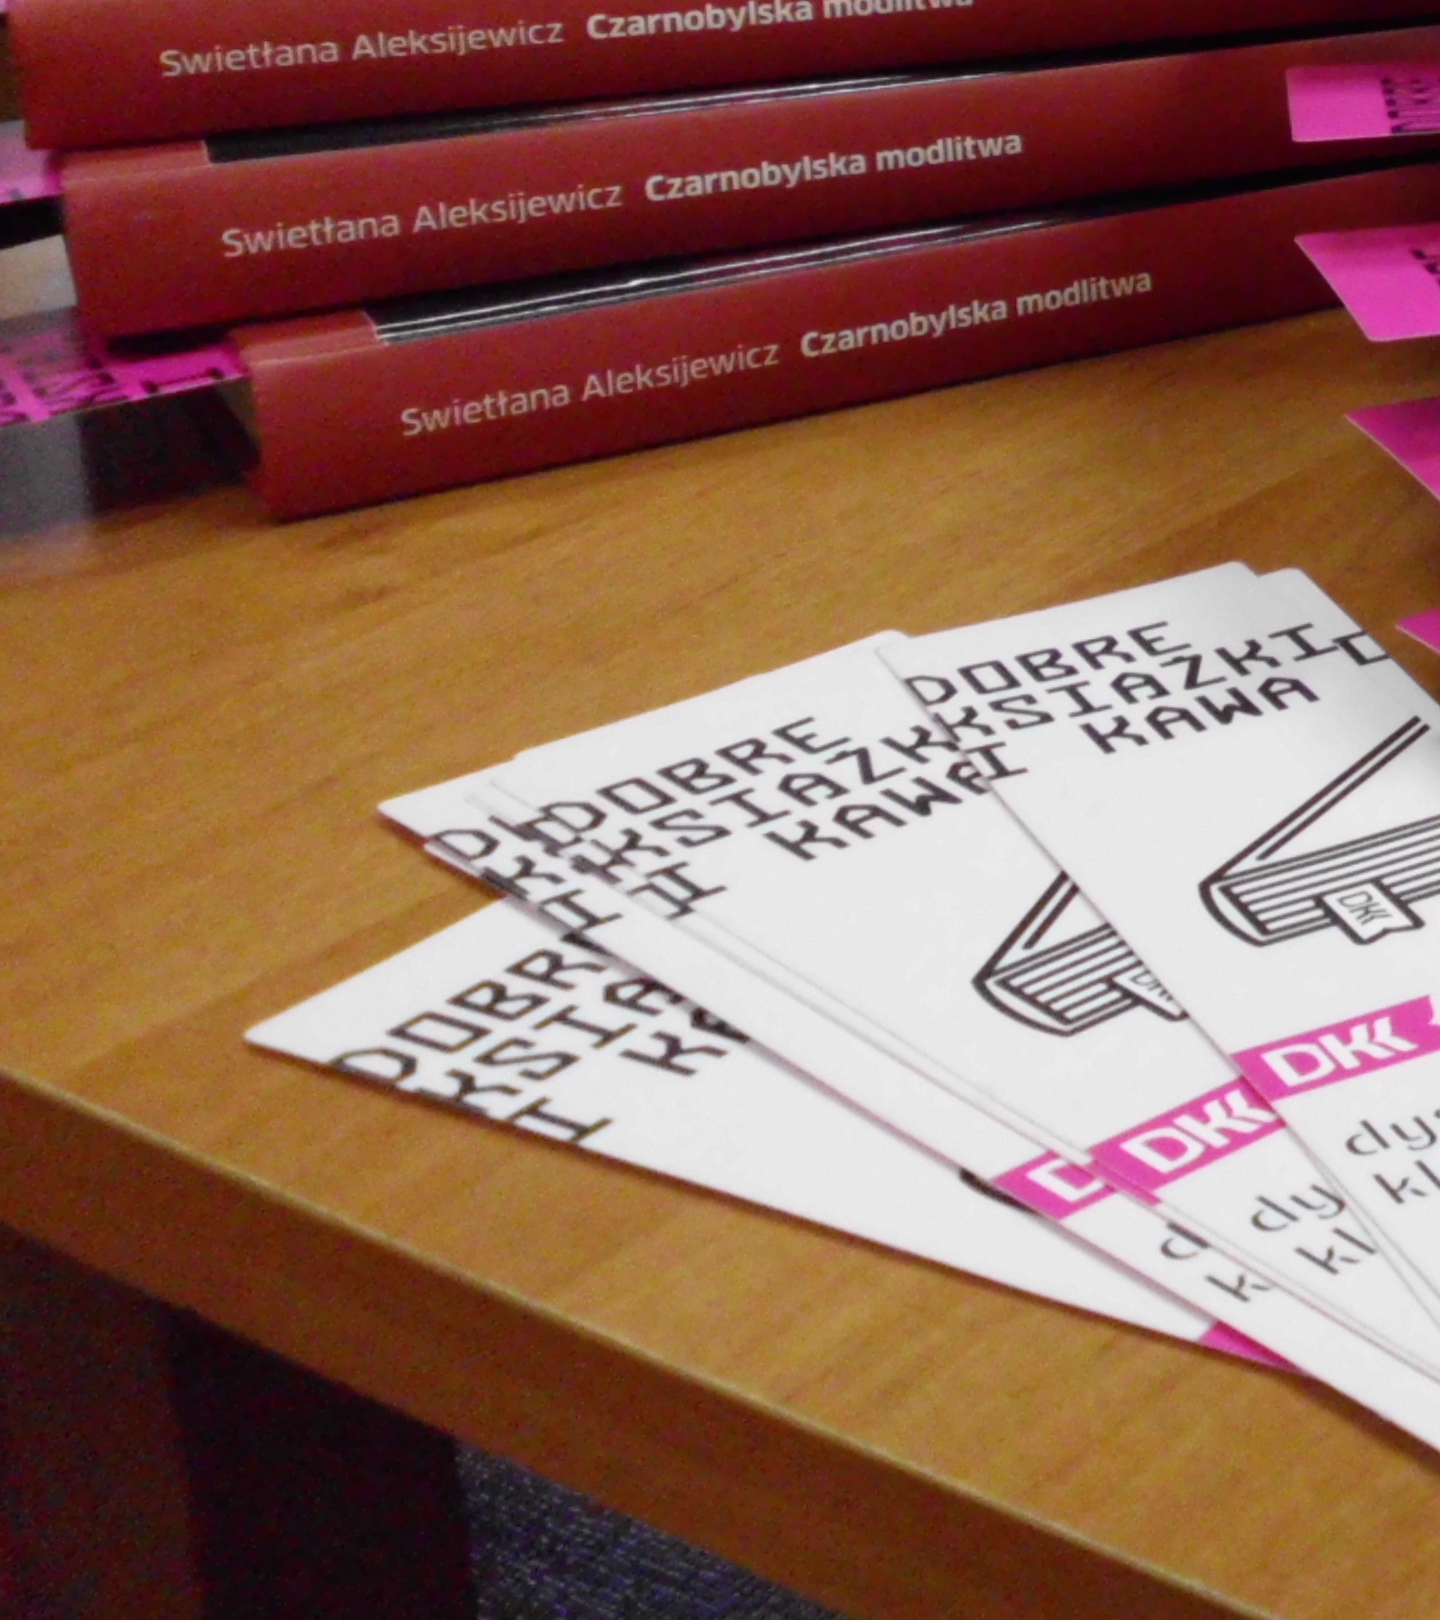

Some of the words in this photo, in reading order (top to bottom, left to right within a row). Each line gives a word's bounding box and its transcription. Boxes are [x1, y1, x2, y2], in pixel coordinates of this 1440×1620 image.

[159, 40, 340, 78] Swietłana
[351, 19, 564, 62] Aleksijewicz
[221, 213, 401, 259] Swietłana
[413, 183, 624, 234] Aleksijewicz
[644, 152, 867, 204] Czarnobylska
[875, 132, 1023, 172] modlitwa
[401, 383, 571, 437] Swietłana
[581, 338, 780, 403] Aleksijewicz
[800, 295, 1008, 360] Czarnobylska
[1016, 268, 1153, 317] modlitwa
[902, 620, 1192, 706] DOBRE
[1080, 676, 1321, 755] KAWA
[540, 716, 853, 835] DOBRE
[1258, 1014, 1419, 1091] DKK
